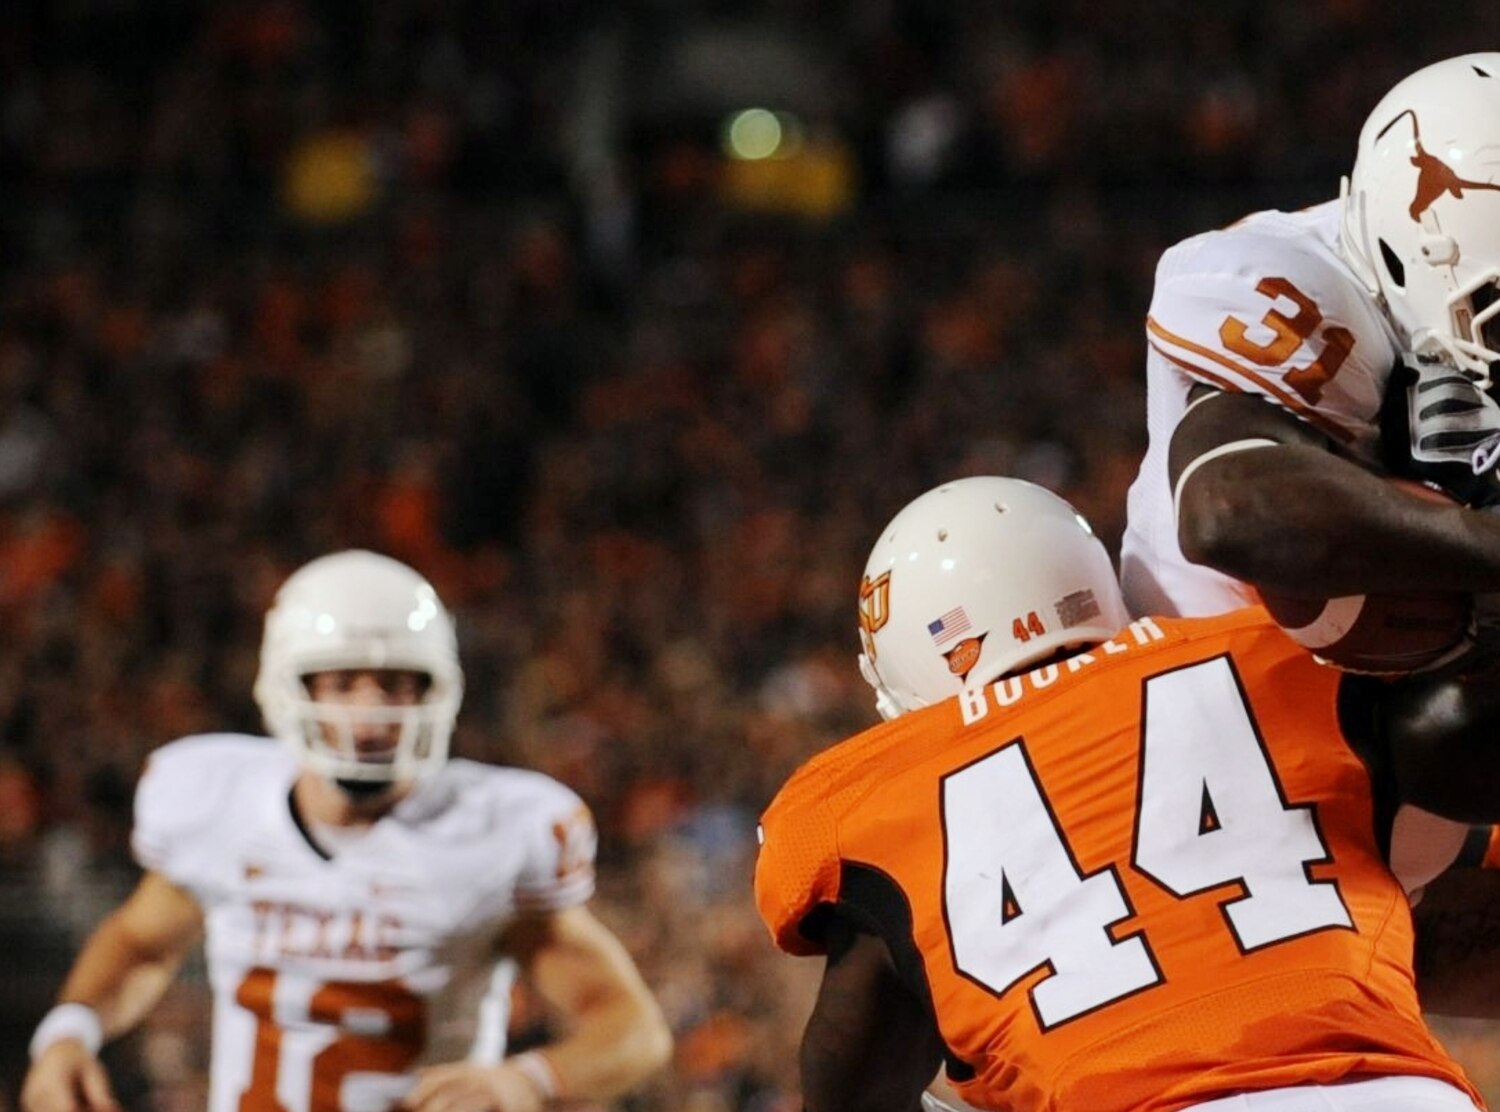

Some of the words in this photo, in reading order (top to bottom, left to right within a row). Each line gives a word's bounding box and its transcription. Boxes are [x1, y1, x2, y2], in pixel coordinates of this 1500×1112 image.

[1219, 277, 1356, 406] 31
[1012, 610, 1046, 643] 44
[939, 651, 1359, 1034] 44
[251, 899, 404, 963] TEXAS
